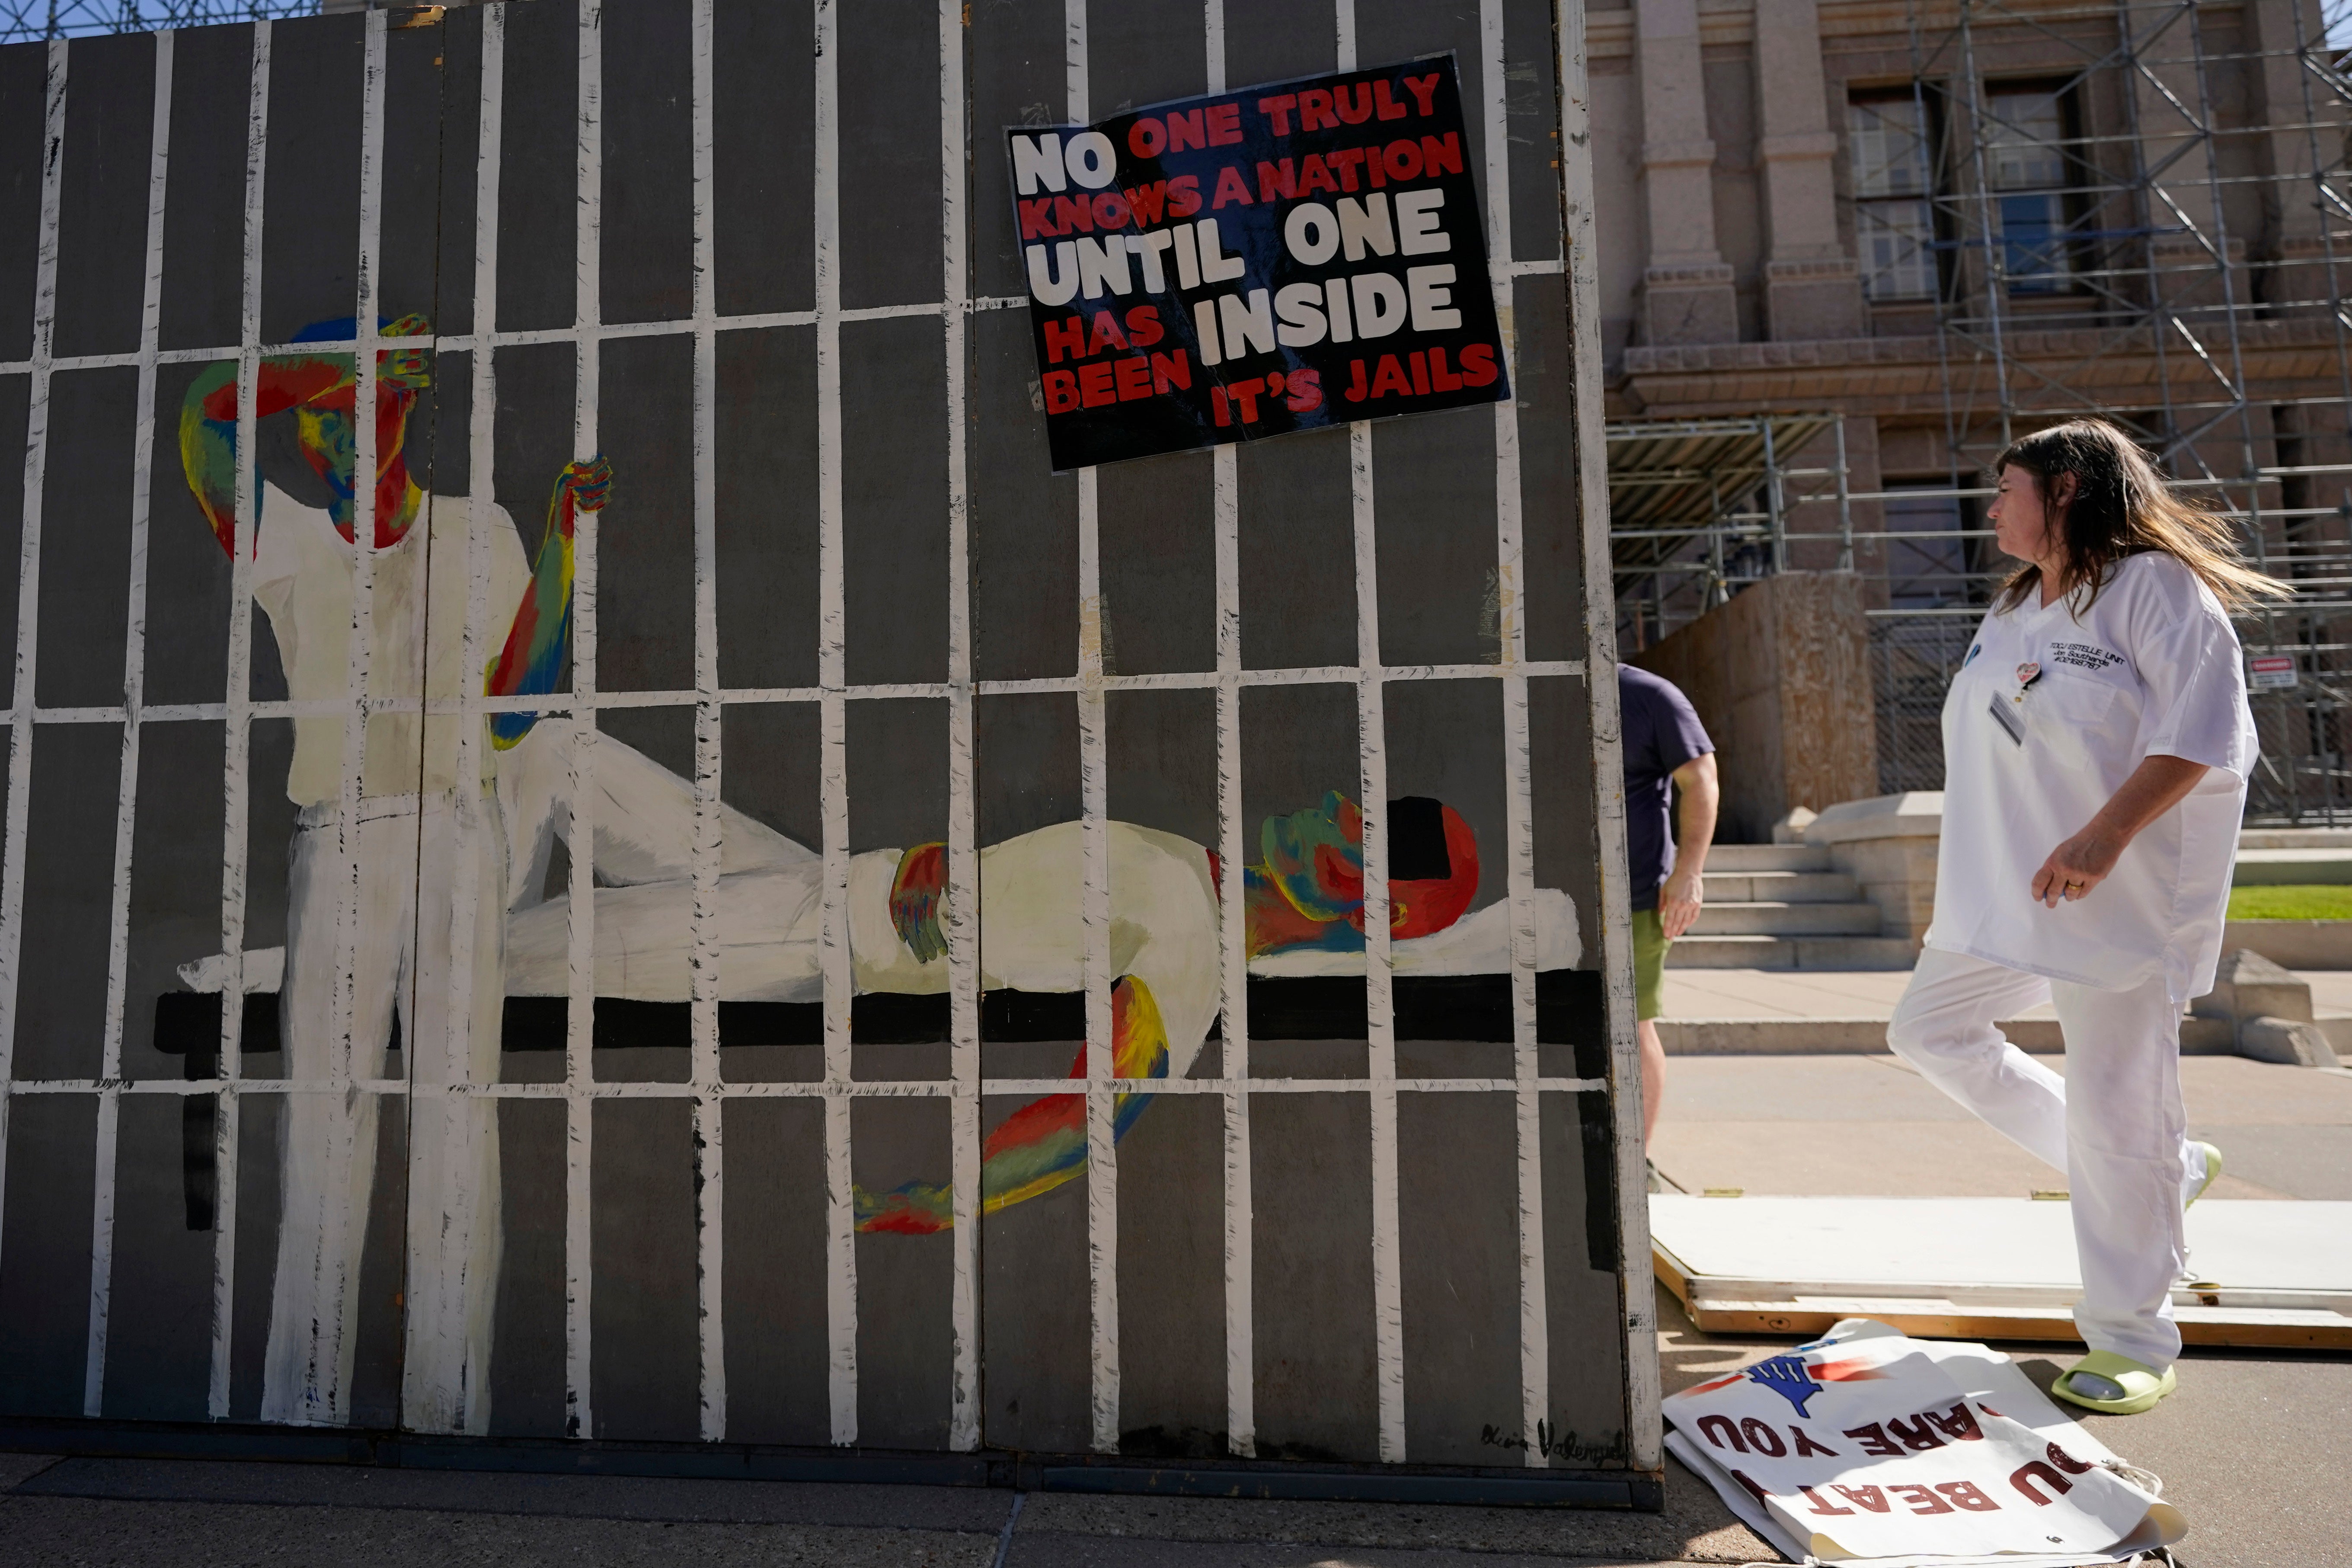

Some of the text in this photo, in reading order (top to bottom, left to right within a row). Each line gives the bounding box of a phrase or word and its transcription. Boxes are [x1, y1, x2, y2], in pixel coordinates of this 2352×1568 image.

[1012, 73, 1440, 195] NO ONE TRULY
[1019, 131, 1464, 240] KNOWS A NATION
[1026, 188, 1451, 307] UNTIL ONE
[1043, 264, 1462, 366] HAS INSIDE
[1042, 348, 1192, 415] BEEN
[1211, 343, 1499, 427] IT'S JAILS
[2068, 644, 2103, 656] ESTELLE
[2105, 652, 2125, 665] UNIT
[1697, 1402, 1984, 1457] ARE YOU
[1803, 1481, 2001, 1515] BEAT
